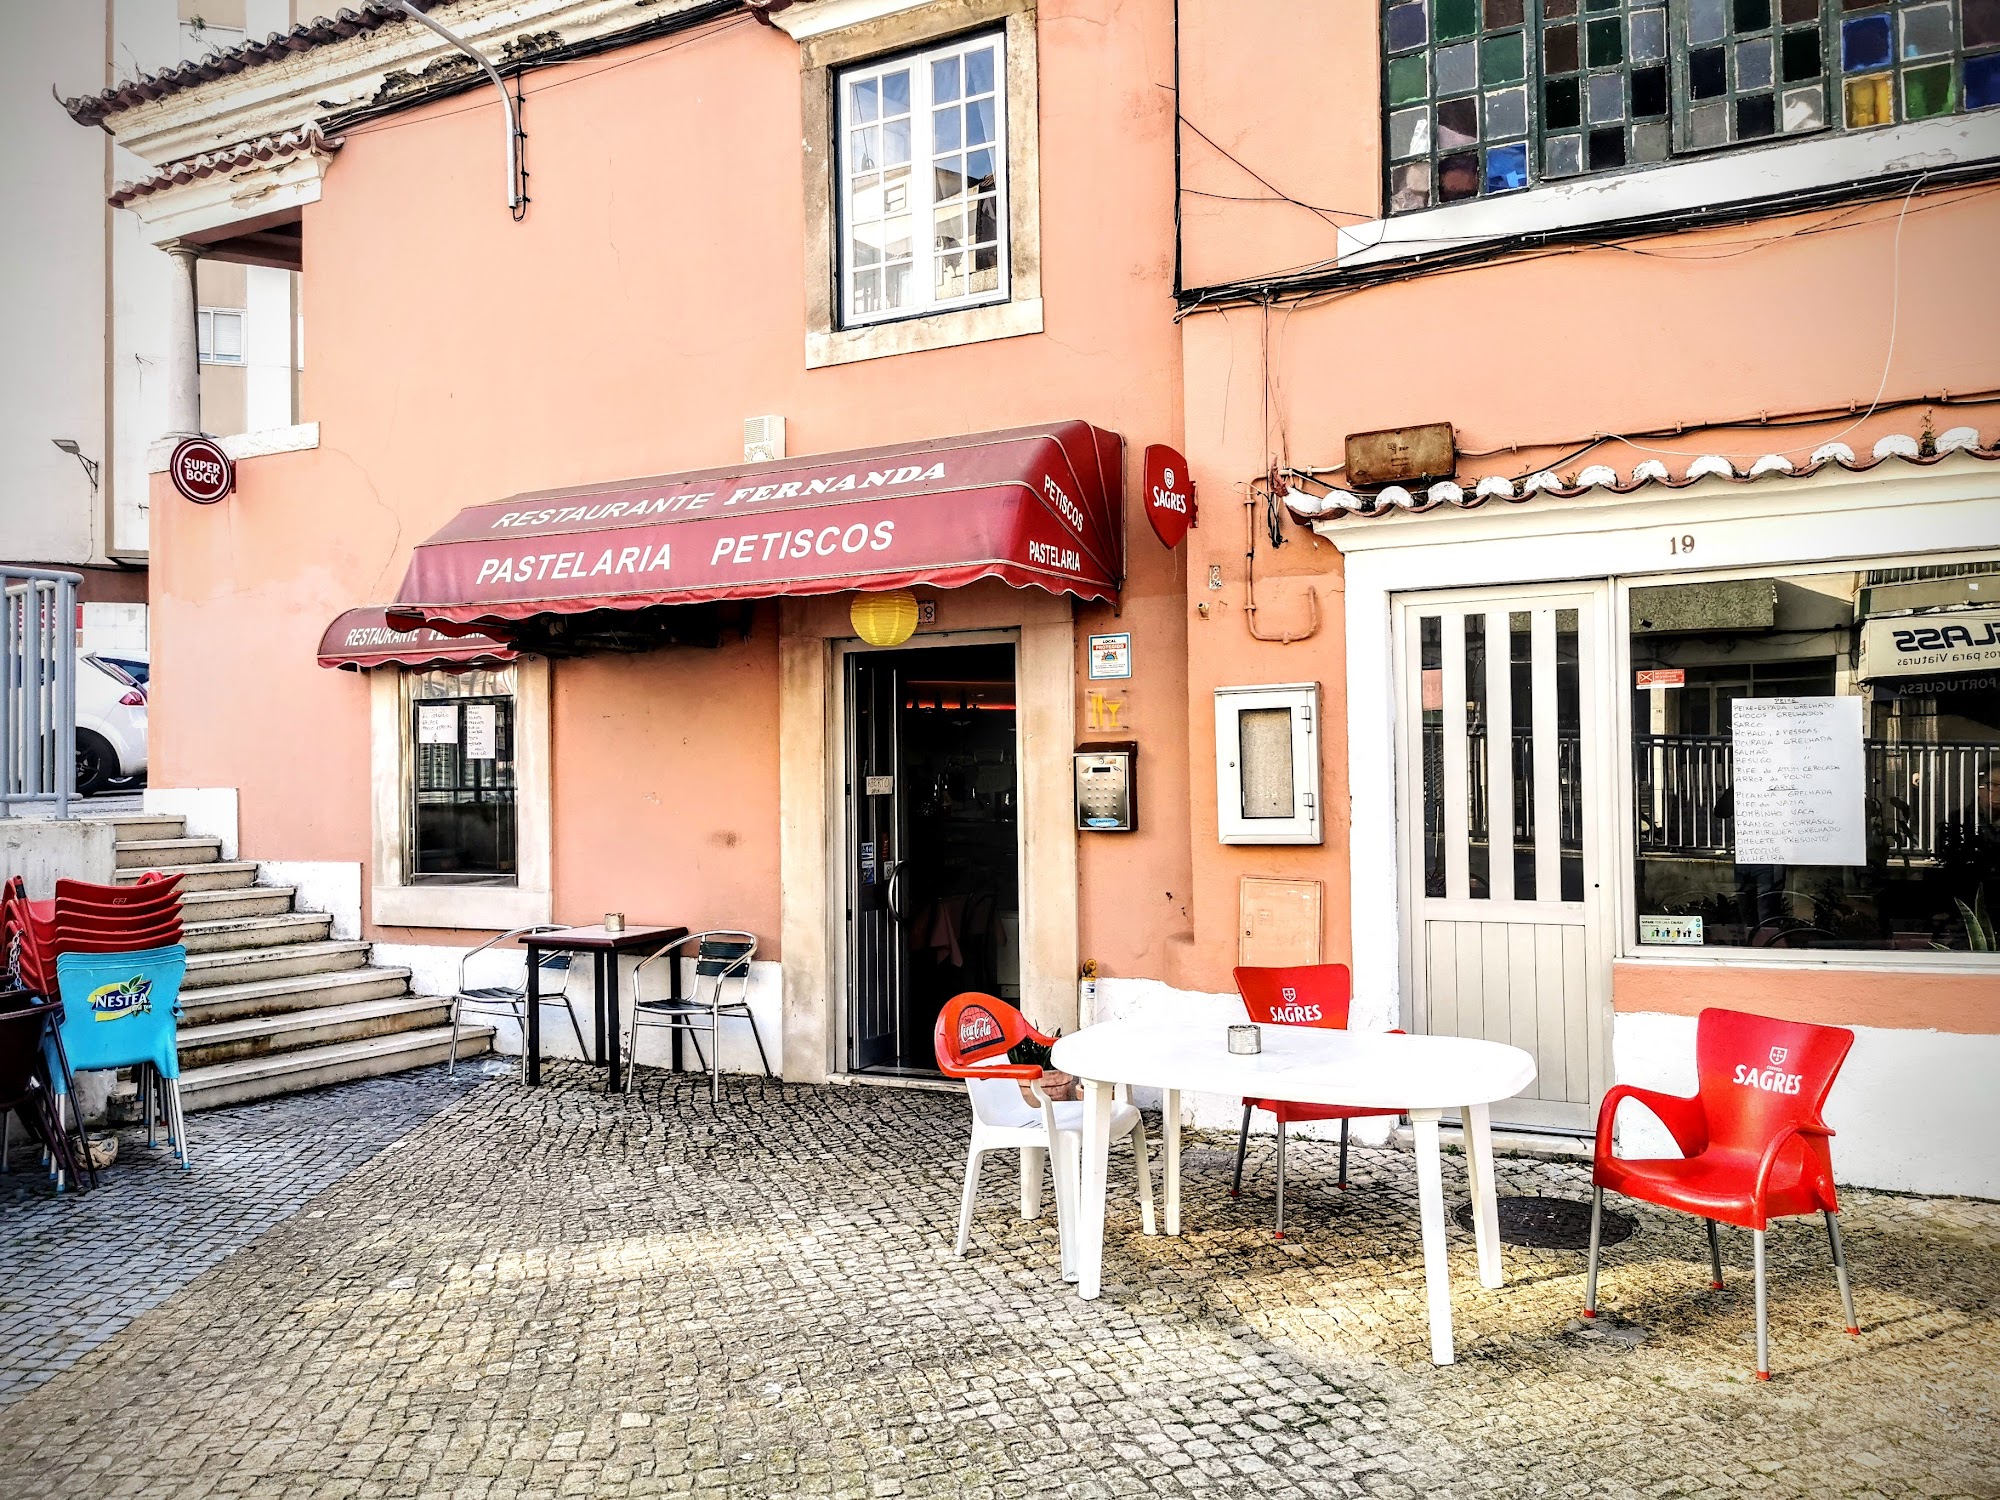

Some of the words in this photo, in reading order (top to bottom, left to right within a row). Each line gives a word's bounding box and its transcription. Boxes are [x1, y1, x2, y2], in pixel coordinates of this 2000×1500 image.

[184, 457, 220, 475] SUPER
[186, 469, 219, 485] BOCK
[491, 492, 716, 529] RESTAURANTE
[723, 462, 946, 506] FERNANDA
[1044, 474, 1084, 532] PETISCOS
[1153, 485, 1187, 514] SAGRES
[475, 543, 671, 585] PASTELARIA
[710, 520, 896, 566] PETISCOS
[1670, 534, 1695, 556] 19
[1029, 540, 1081, 572] PASTELARIA
[345, 627, 420, 646] RESTAURANTE
[1734, 739, 1774, 747] DOURADA
[1783, 736, 1833, 745] GRELHADA
[1787, 789, 1833, 797] GRELHADA
[1791, 808, 1815, 816] VACA
[1782, 819, 1835, 827] CHURRASCO
[1738, 847, 1781, 855] BITOQUE
[95, 992, 148, 1008] NESTEA
[1269, 1004, 1323, 1023] SAGRES
[961, 1016, 991, 1042] Coca-Cola
[1732, 1064, 1803, 1095] SAGRES
